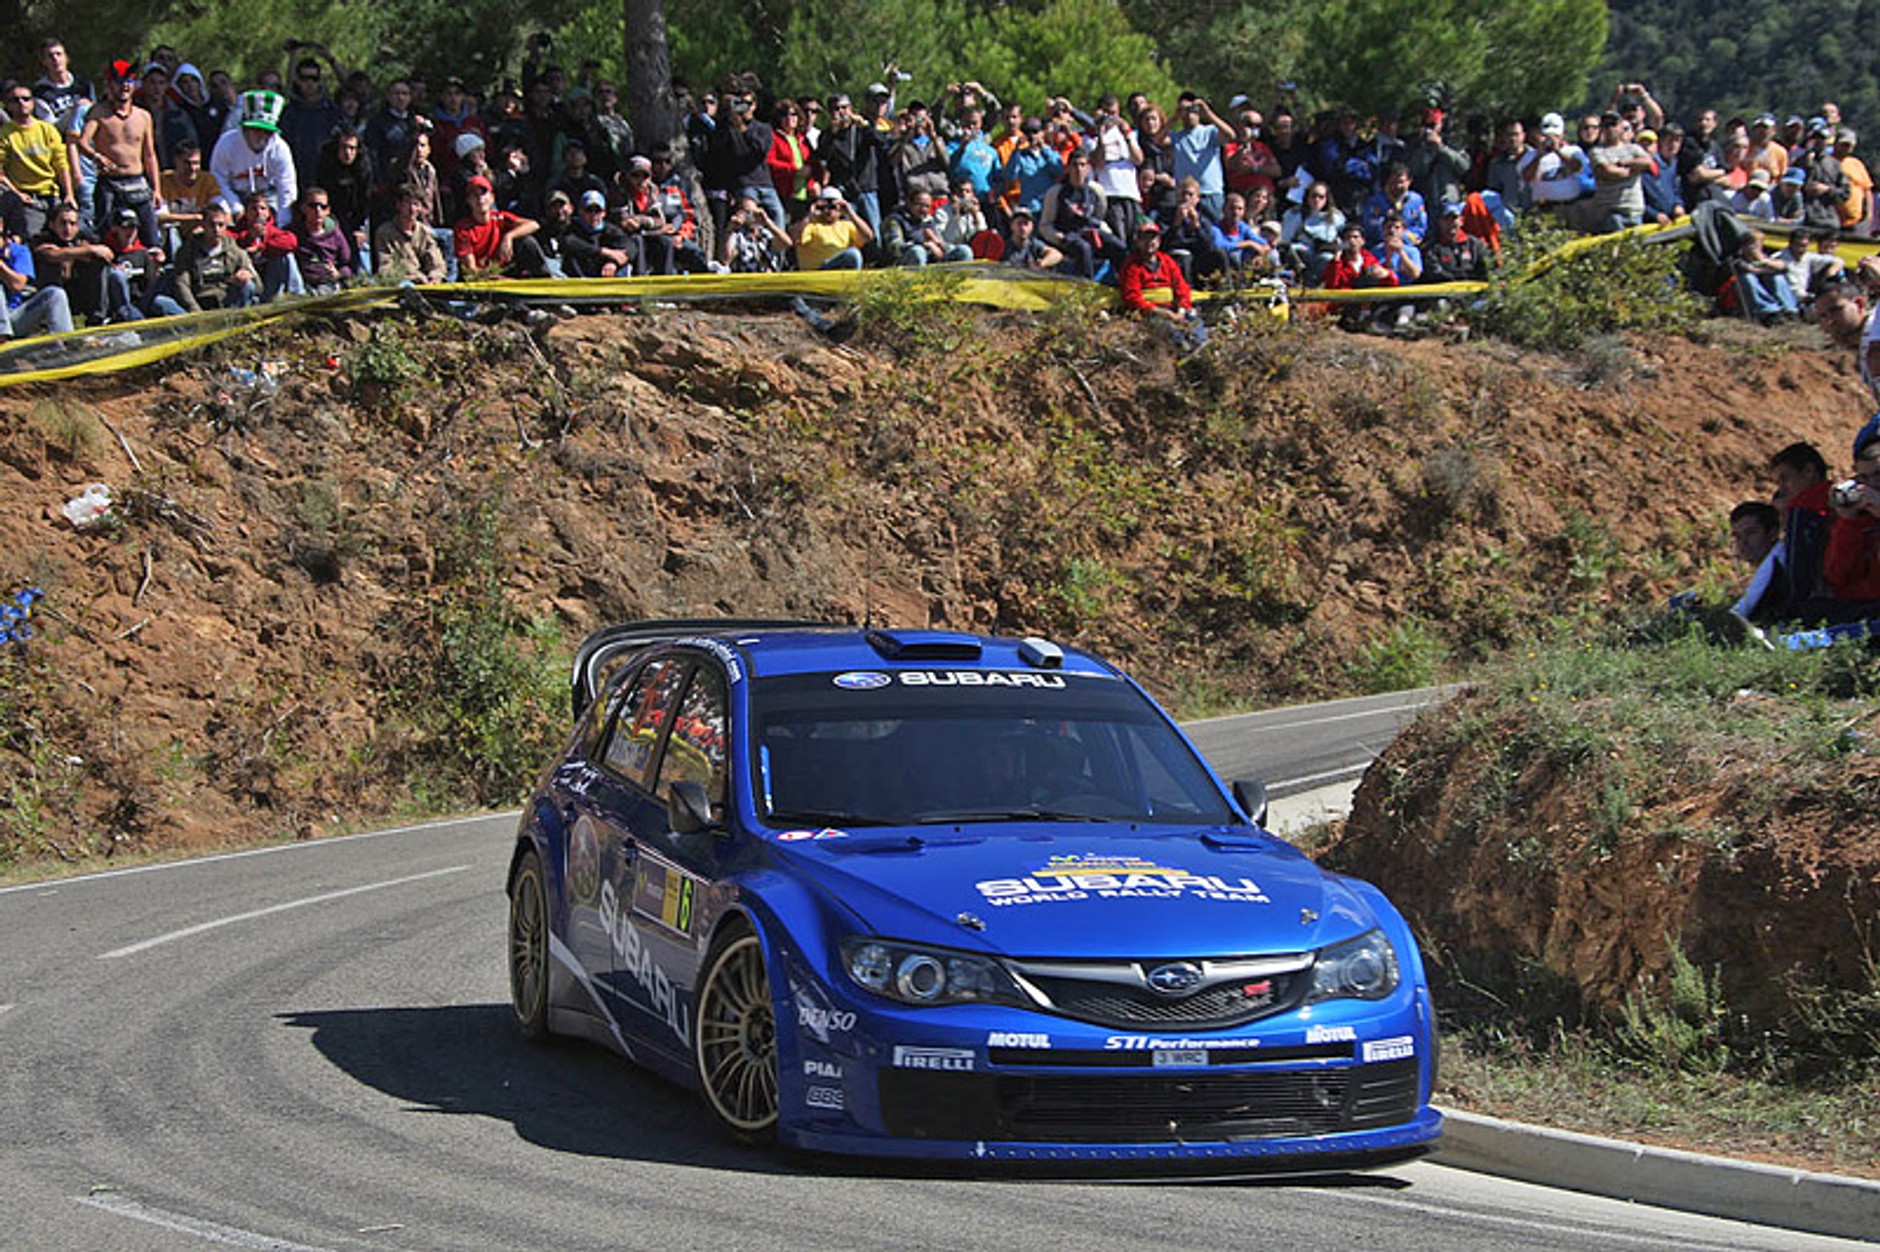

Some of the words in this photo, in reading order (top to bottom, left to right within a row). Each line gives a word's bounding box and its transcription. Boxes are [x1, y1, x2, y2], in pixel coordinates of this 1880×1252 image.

[899, 671, 1066, 689] SUBARU
[975, 873, 1262, 897] SUBARU
[679, 878, 692, 932] 6
[987, 891, 1089, 906] WORLD
[1098, 888, 1182, 899] RALLY
[1191, 889, 1271, 903] TEAM
[599, 879, 692, 1050] SUBARU
[799, 1007, 857, 1031] DENSO
[987, 1032, 1052, 1048] MOTUL
[1104, 1035, 1148, 1049] STI
[1148, 1037, 1261, 1049] Performance
[1306, 1024, 1357, 1044] MOTUL
[893, 1045, 976, 1071] PIRELLI
[1173, 1052, 1203, 1063] WRC
[1362, 1035, 1414, 1063] PIRELLI
